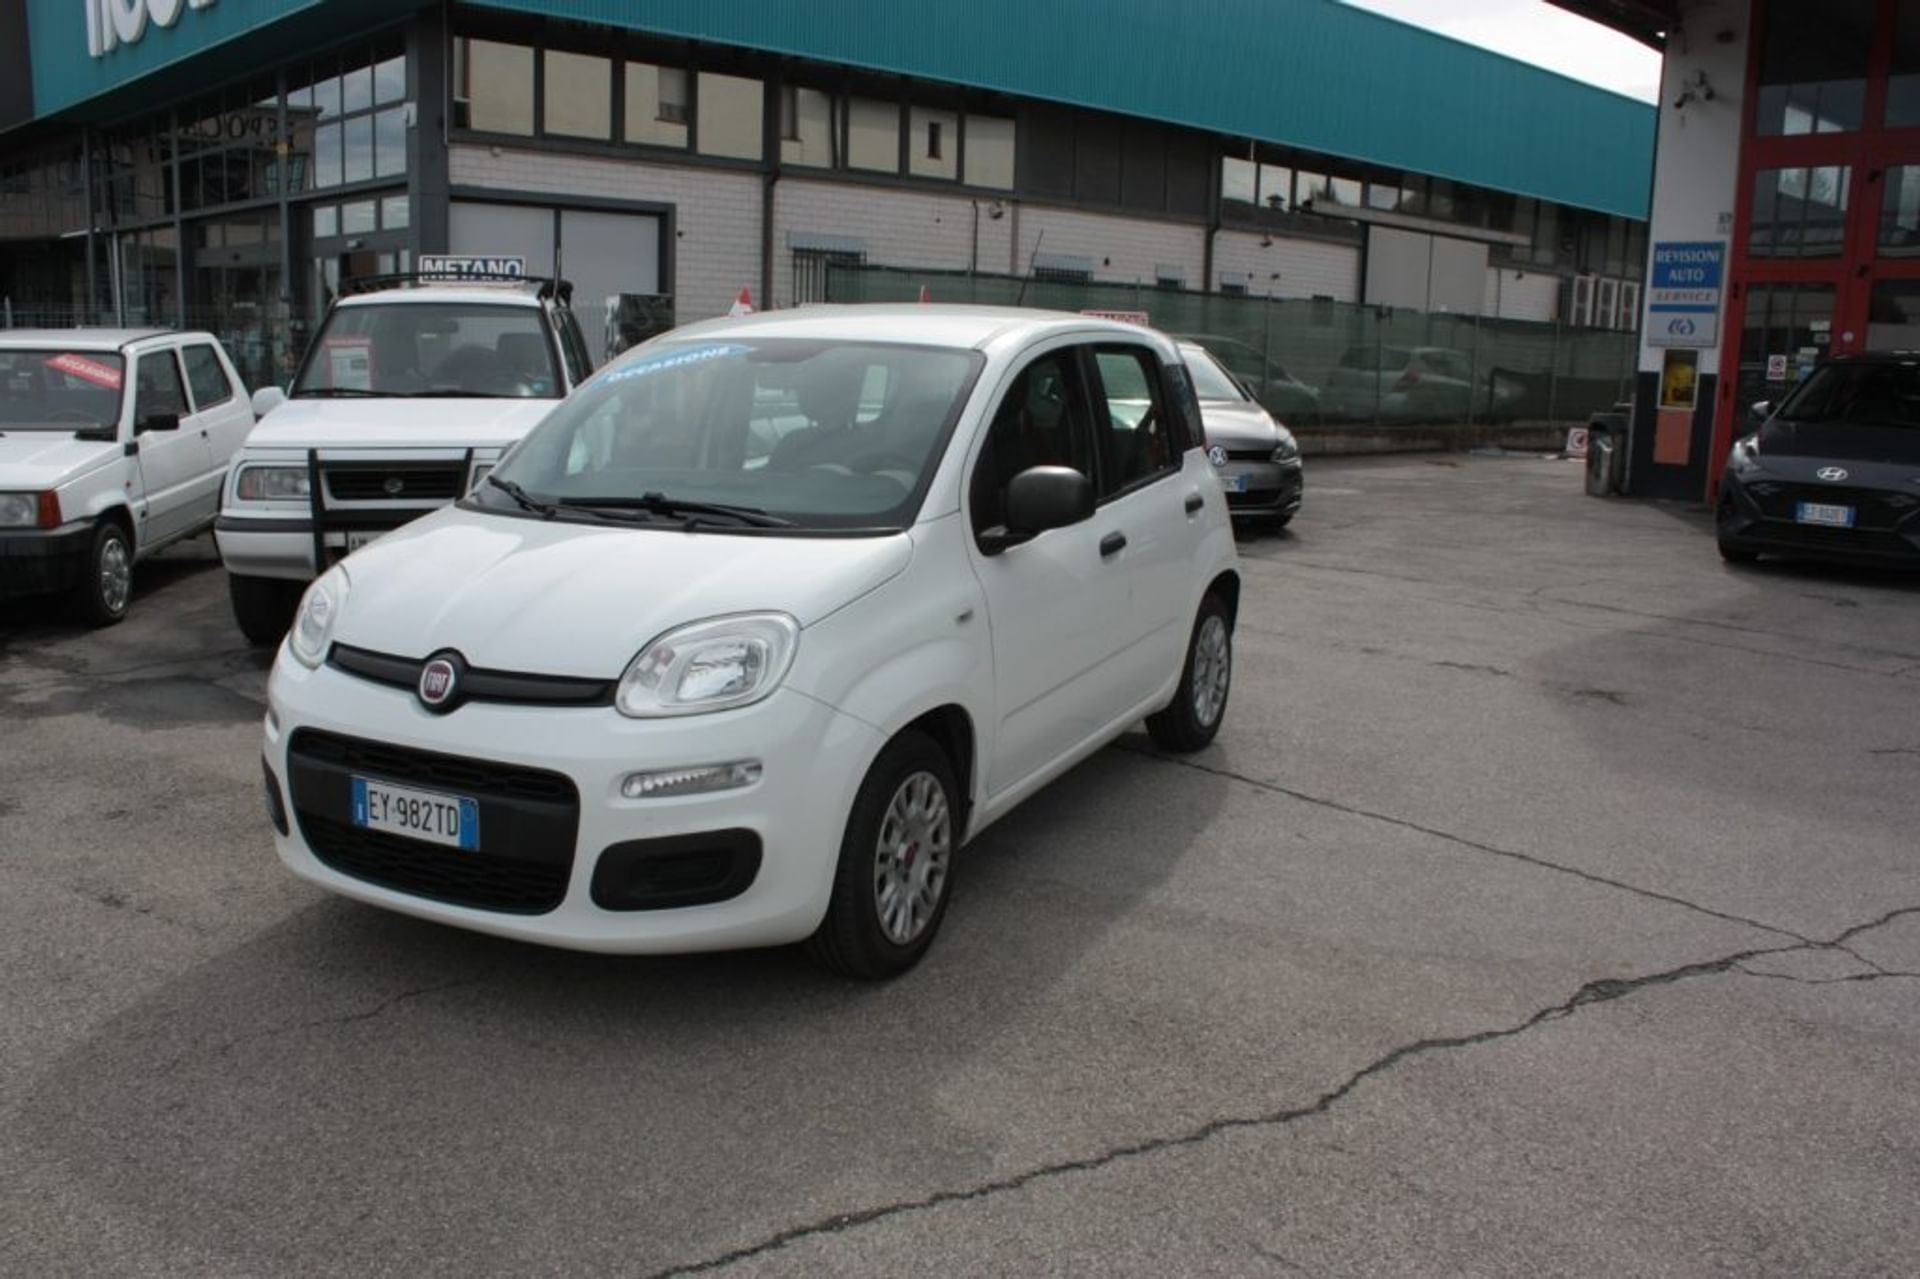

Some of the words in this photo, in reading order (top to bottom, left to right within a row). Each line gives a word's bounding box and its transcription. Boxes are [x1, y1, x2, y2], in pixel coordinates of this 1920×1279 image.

[1655, 249, 1719, 264] REVISIONI
[423, 258, 521, 281] METANO
[1668, 267, 1706, 282] AUTO
[426, 671, 449, 693] FIAT
[368, 789, 390, 822] EY
[396, 796, 458, 836] 982TD
